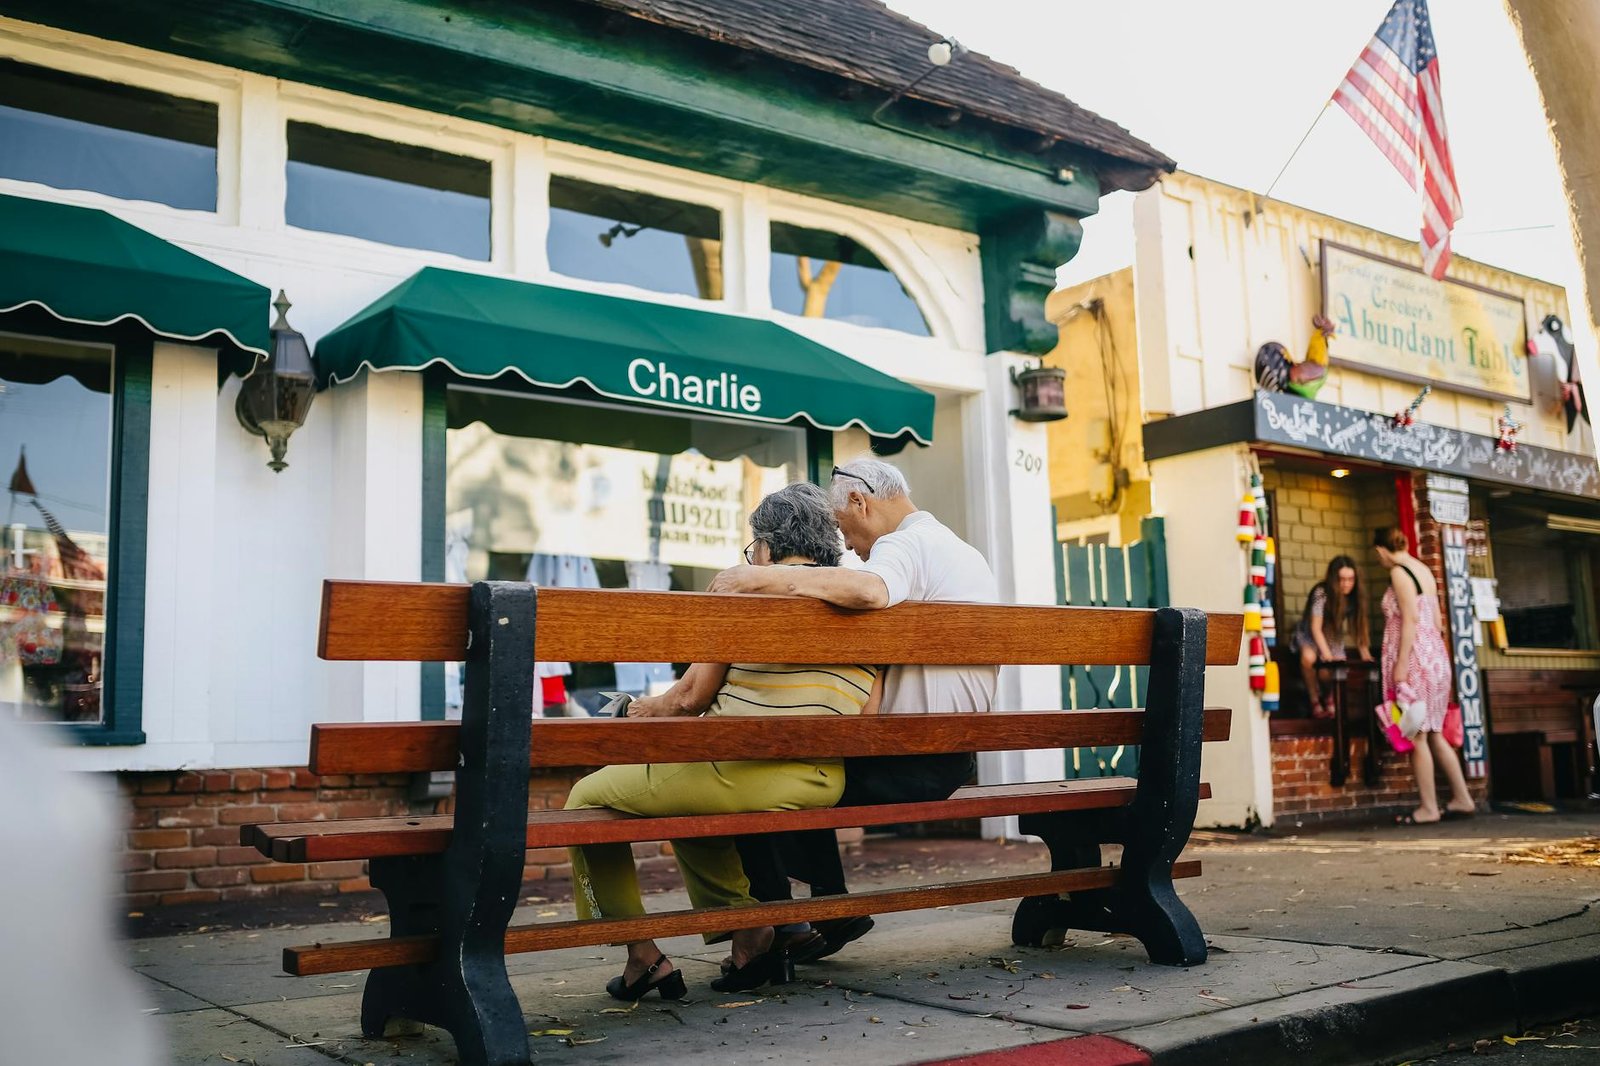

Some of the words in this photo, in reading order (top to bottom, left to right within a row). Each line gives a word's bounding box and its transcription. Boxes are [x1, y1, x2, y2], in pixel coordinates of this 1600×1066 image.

[1335, 293, 1455, 362] Abundant
[1461, 326, 1522, 376] Table
[627, 357, 762, 412] Charlie
[1014, 448, 1042, 476] 209
[1446, 548, 1484, 759] WELCOME
